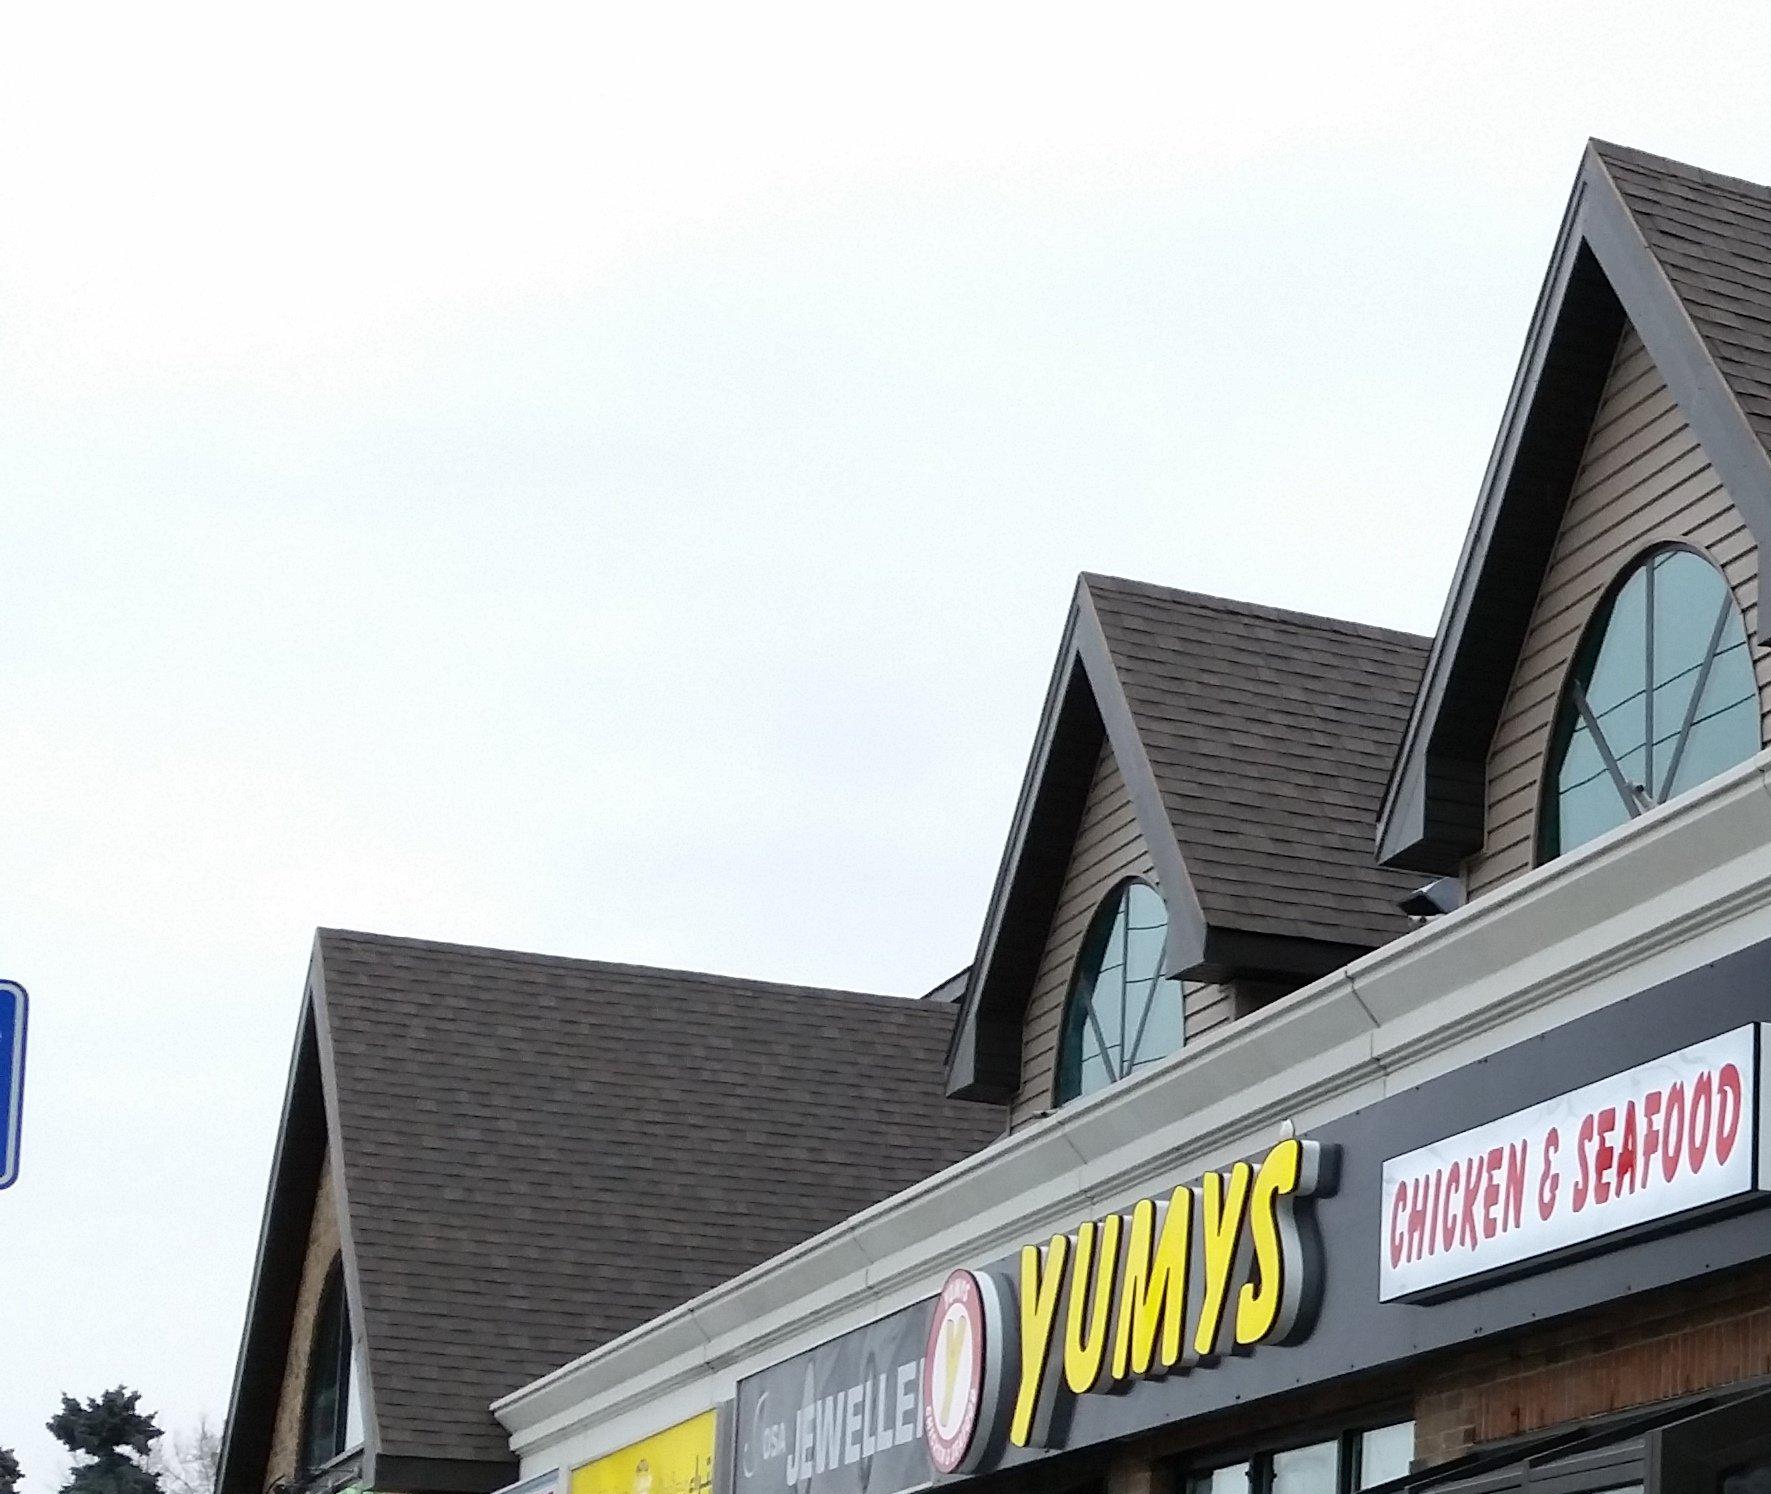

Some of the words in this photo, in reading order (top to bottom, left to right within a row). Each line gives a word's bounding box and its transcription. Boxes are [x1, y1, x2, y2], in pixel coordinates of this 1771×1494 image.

[1010, 1138, 1302, 1448] YUMYS
[1388, 1139, 1528, 1270] CHICKEN
[1537, 1127, 1560, 1221] &
[1573, 1062, 1742, 1214] SEAFOOD
